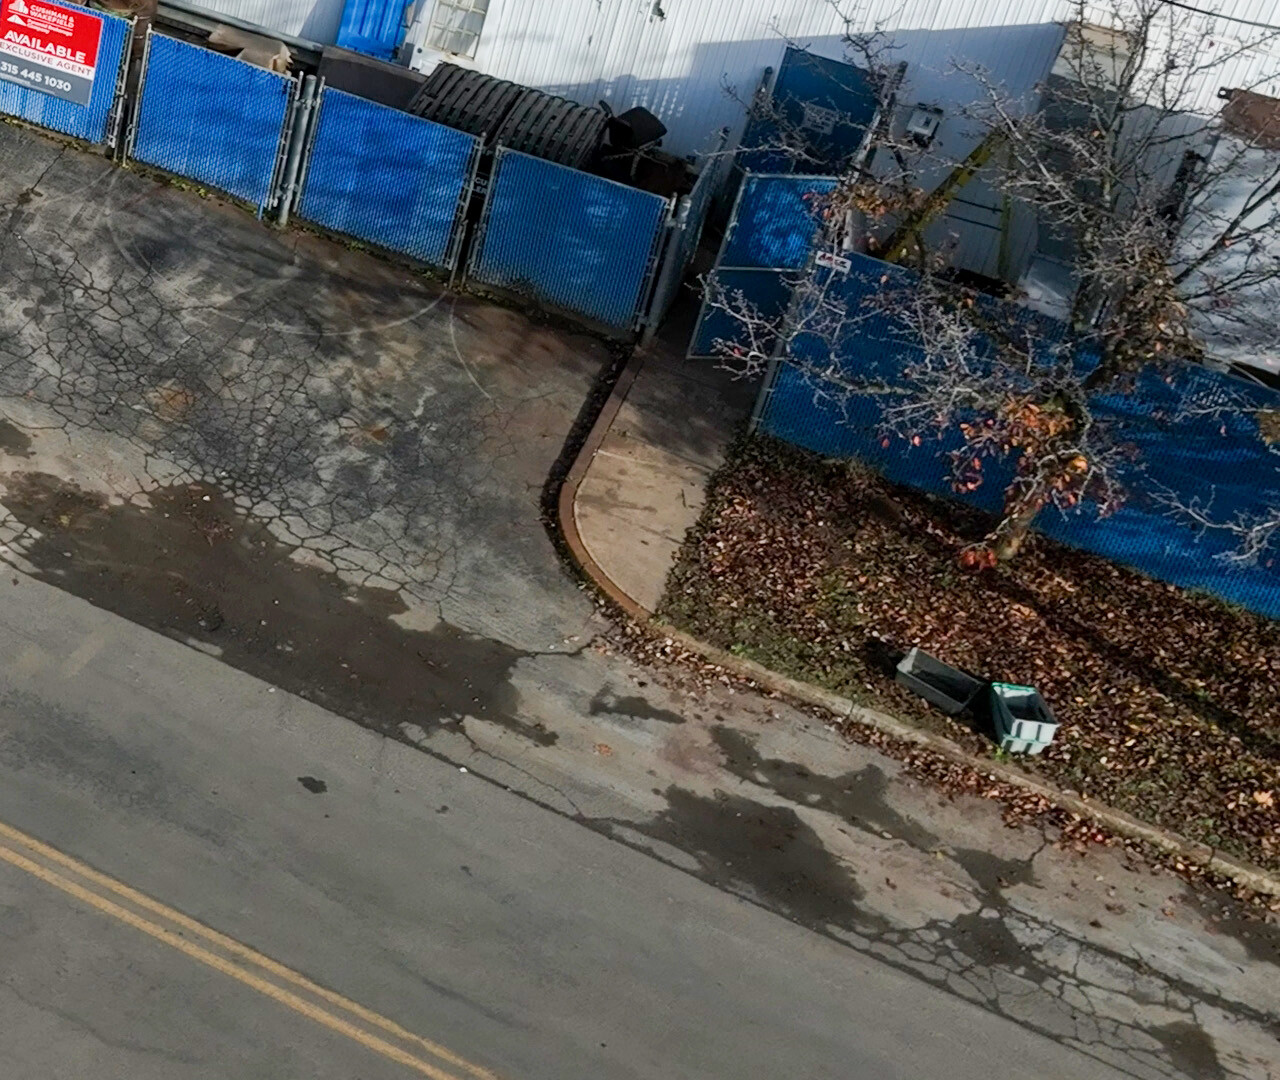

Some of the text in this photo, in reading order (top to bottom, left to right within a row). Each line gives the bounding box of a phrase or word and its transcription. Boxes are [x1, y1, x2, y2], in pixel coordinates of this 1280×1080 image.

[29, 4, 67, 20] CUSHMAN
[29, 9, 75, 29] WAKEFIELD
[0, 41, 92, 77] EXCLUSIVE AGENT
[4, 29, 87, 64] AVAILABLE
[0, 61, 19, 75] 315
[20, 68, 42, 83] 445
[44, 75, 72, 92] 1030
